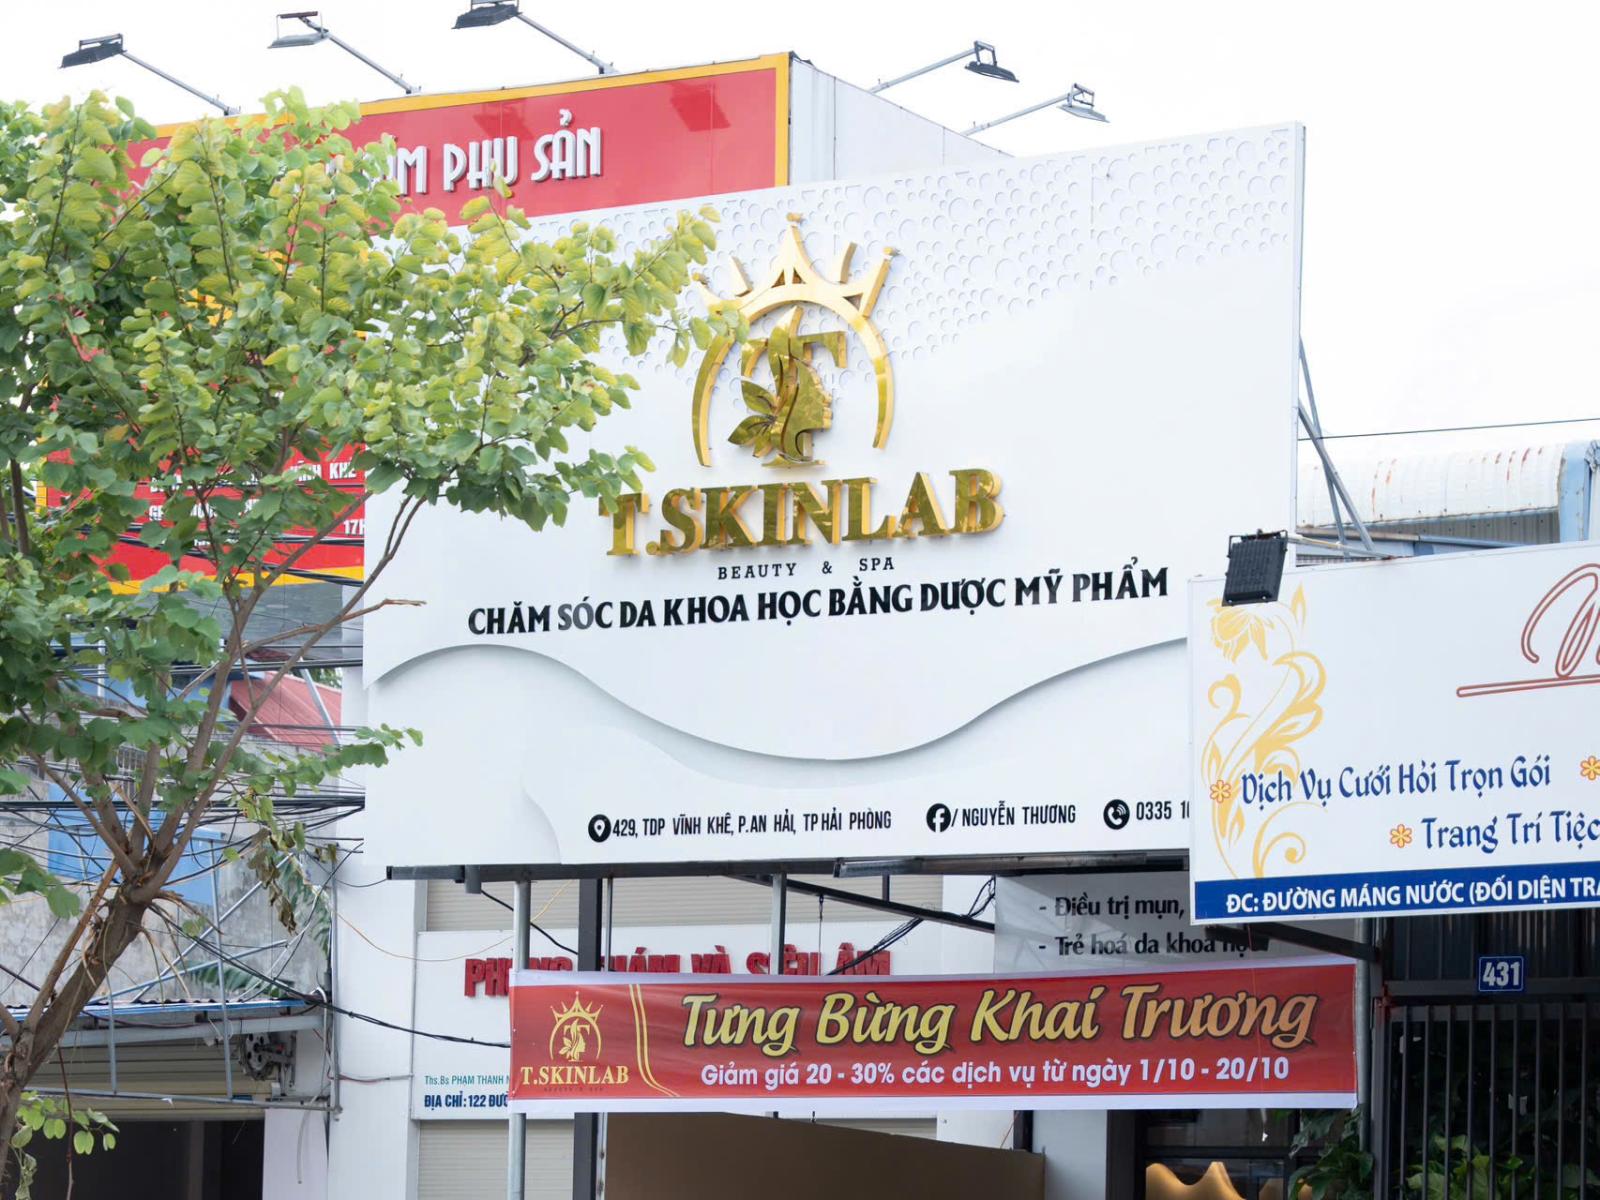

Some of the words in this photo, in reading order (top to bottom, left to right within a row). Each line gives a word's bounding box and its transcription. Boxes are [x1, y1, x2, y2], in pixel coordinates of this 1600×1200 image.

[531, 109, 601, 182] SẢN
[598, 469, 1004, 556] T.SKINLAB
[718, 562, 797, 580] BEAUTY
[821, 561, 833, 574] &
[859, 557, 895, 571] SPA
[468, 601, 551, 635] CHĂM
[558, 596, 613, 631] SÓC
[620, 600, 656, 628] DA
[663, 594, 749, 627] KHOA
[757, 589, 821, 626] HỌC
[828, 575, 913, 616] BẰNG
[920, 577, 1006, 615] DƯỢC
[1014, 568, 1064, 606] MỸ
[1072, 556, 1169, 602] PHẨM
[1241, 769, 1291, 810] Dịch
[1299, 769, 1332, 807] Vụ
[1339, 764, 1391, 798] Cưới
[1398, 759, 1436, 794] Hỏi
[1444, 758, 1504, 799] Trọn
[1510, 754, 1551, 789] Gói
[612, 818, 638, 838] 429,
[643, 818, 665, 836] TDP
[673, 813, 701, 835] VĨNH
[707, 812, 734, 836] KHÊ,
[738, 815, 767, 834] P.AN
[821, 807, 843, 831] HẢI
[849, 807, 892, 830] PHÒNG
[1022, 803, 1076, 825] THƯƠNG
[1136, 801, 1172, 820] 0335
[1421, 816, 1499, 854] Trang
[1507, 812, 1542, 846] Trí
[1550, 810, 1600, 849] Tiệc
[1055, 893, 1100, 917] Điều
[1107, 895, 1129, 920] trị
[1135, 899, 1185, 920] mụn,
[1226, 893, 1259, 914] ĐC:
[1262, 884, 1336, 912] ĐƯỜNG
[1340, 883, 1400, 908] MÁNG
[1406, 879, 1464, 904] NƯỚC
[1469, 875, 1513, 904] (ĐỐI
[1518, 875, 1566, 903] DIỆN
[1055, 933, 1084, 956] Trẻ
[1091, 933, 1127, 955] hoá
[1134, 932, 1159, 954] da
[1166, 931, 1216, 954] khoa
[1482, 961, 1520, 986] 431
[682, 993, 800, 1057] Tưng
[815, 990, 957, 1056] Bừng
[1121, 983, 1318, 1050] Trương
[476, 1075, 504, 1085] THANH
[521, 1065, 629, 1085] T.SKINLAB
[701, 1061, 758, 1085] Giảm
[765, 1062, 799, 1090] giá
[806, 1064, 832, 1085] 20
[852, 1062, 895, 1084] 30%
[902, 1059, 945, 1084] các
[952, 1061, 1001, 1089] dịch
[1009, 1062, 1035, 1088] vụ
[1043, 1058, 1068, 1082] từ
[1072, 1058, 1132, 1088] ngày
[1140, 1058, 1195, 1083] 1/10
[1216, 1056, 1289, 1081] 20/10
[424, 1094, 442, 1110] ĐỊA
[468, 1094, 487, 1107] 122
